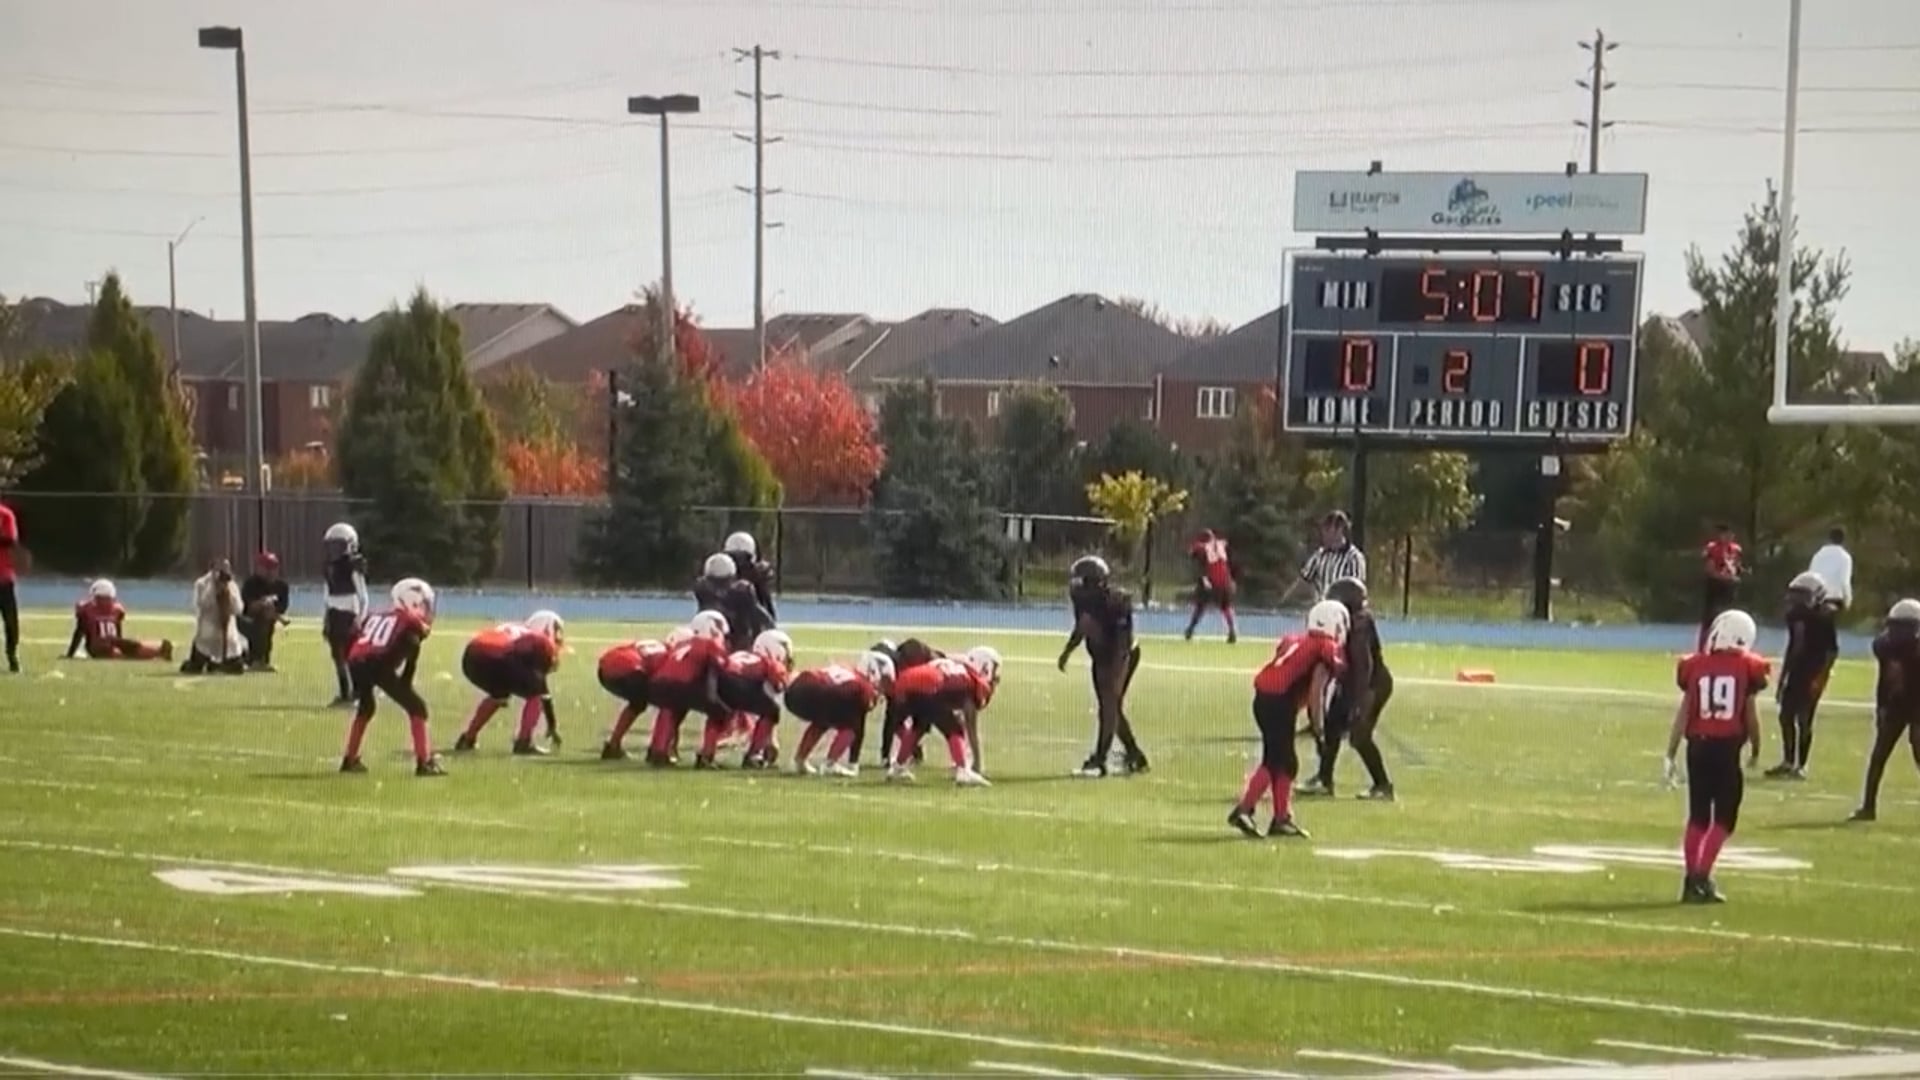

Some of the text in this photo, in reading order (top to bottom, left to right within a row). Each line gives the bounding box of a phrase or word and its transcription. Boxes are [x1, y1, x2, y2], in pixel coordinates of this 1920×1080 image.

[1323, 281, 1367, 309] MIN
[1421, 268, 1540, 321] 5:07
[1558, 283, 1603, 312] SEC
[1344, 338, 1373, 392] 0
[1445, 351, 1469, 393] 2
[1579, 342, 1611, 395] 0
[1307, 397, 1369, 425] HOME
[1410, 399, 1501, 428] PERIOD
[1528, 401, 1619, 430] GUESTS
[358, 615, 398, 646] 90
[1698, 675, 1736, 720] 19
